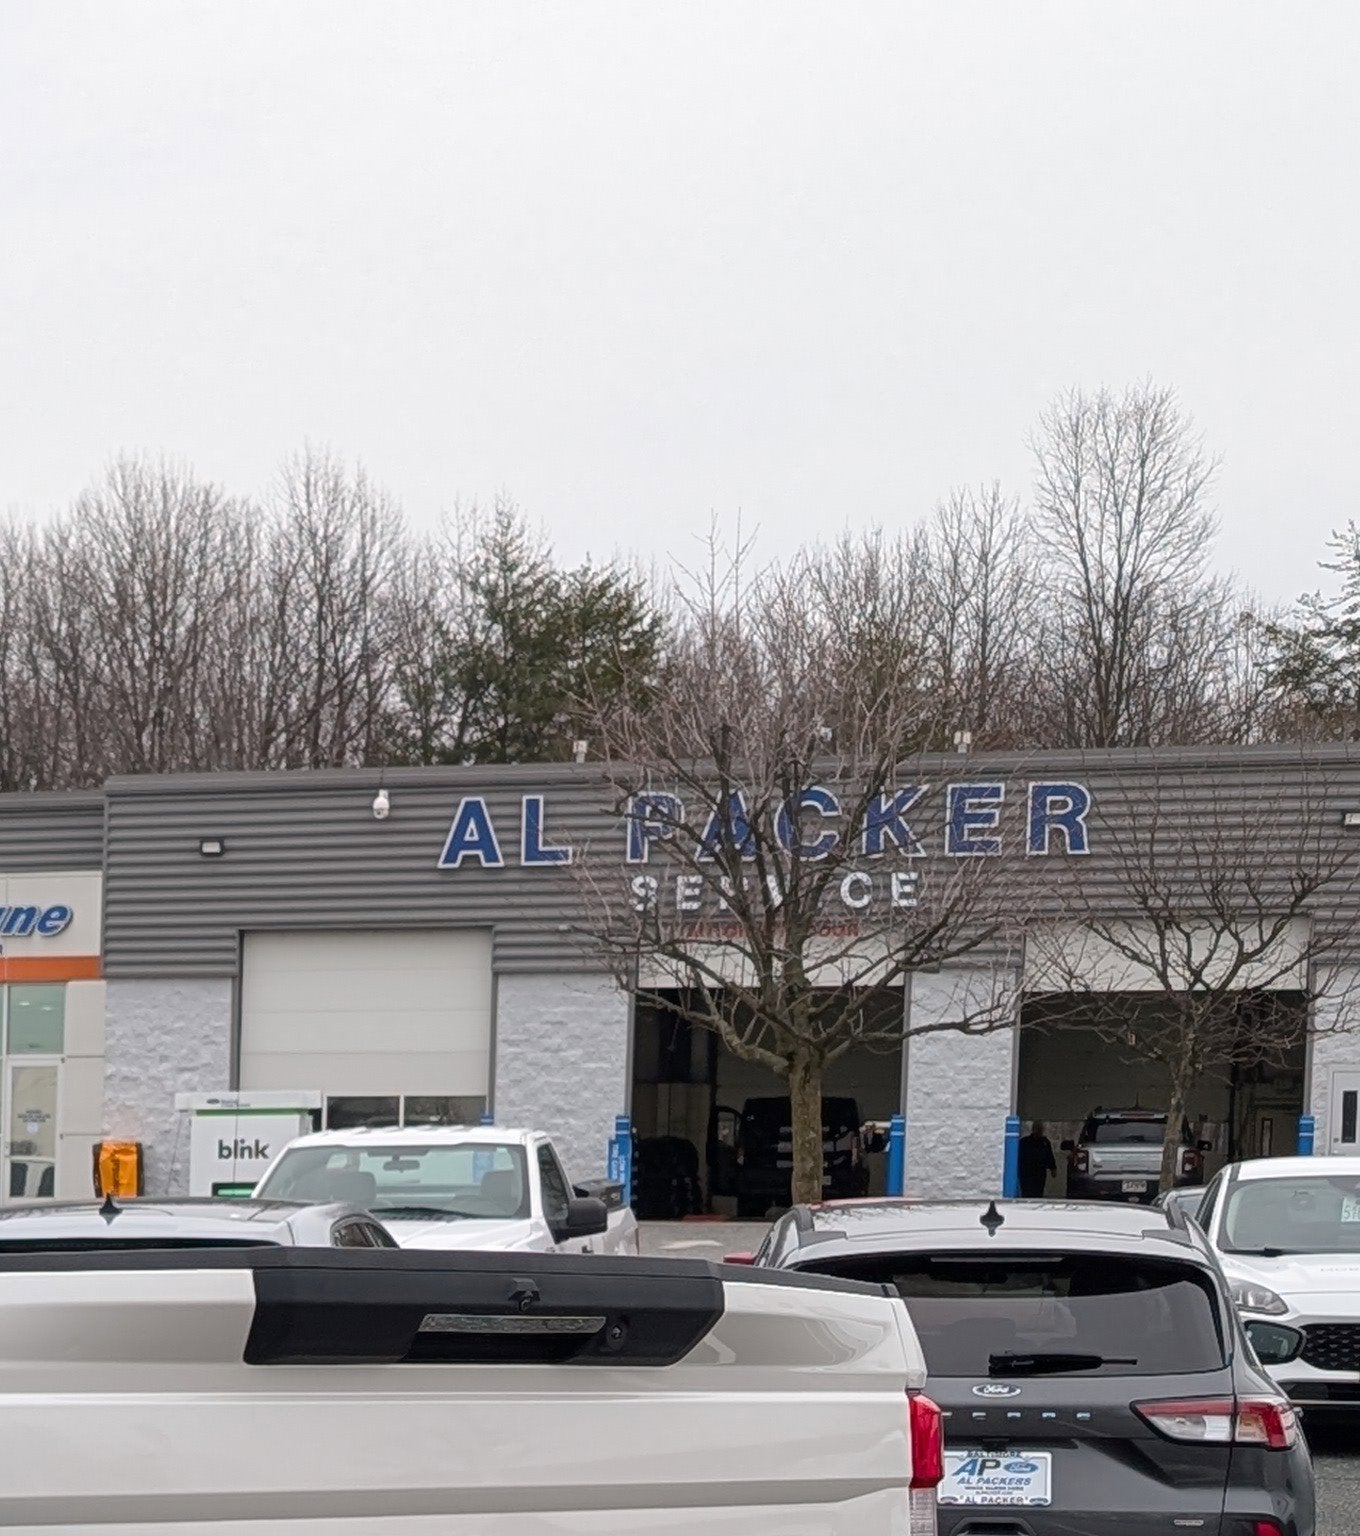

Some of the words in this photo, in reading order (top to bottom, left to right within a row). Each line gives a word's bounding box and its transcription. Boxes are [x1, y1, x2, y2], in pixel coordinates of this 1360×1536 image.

[438, 795, 573, 868] AL
[624, 781, 1091, 863] PACKER
[630, 871, 920, 911] SERVCE
[217, 1138, 270, 1160] blink
[983, 1384, 1010, 1394] Ford
[951, 1458, 1001, 1477] AP
[957, 1477, 973, 1485] AL
[975, 1477, 1032, 1486] PACKERS
